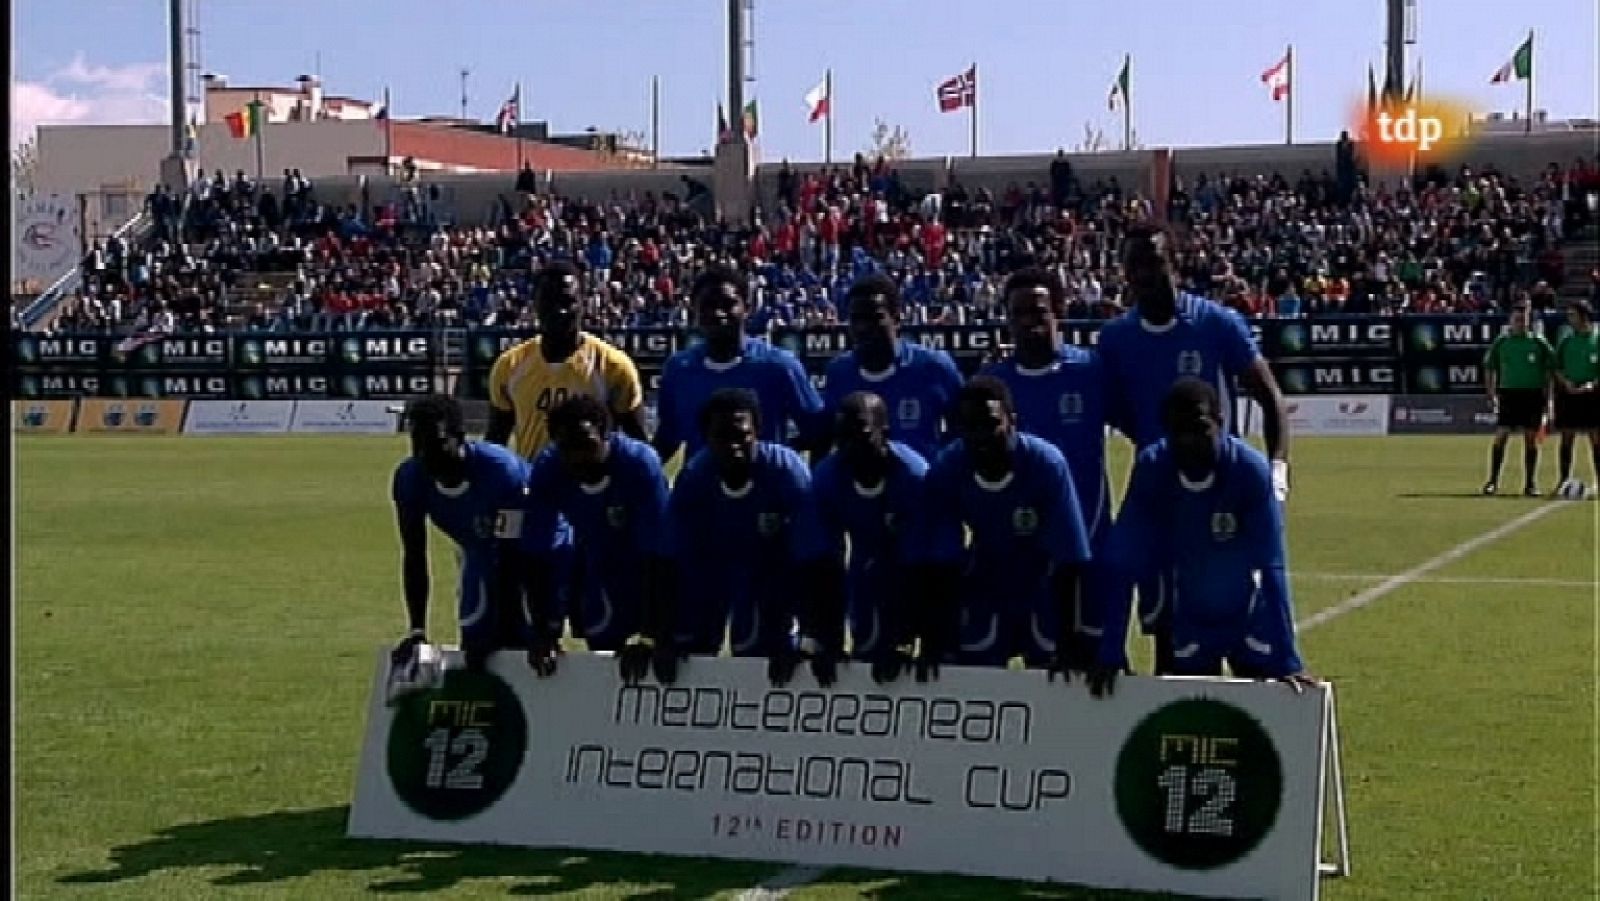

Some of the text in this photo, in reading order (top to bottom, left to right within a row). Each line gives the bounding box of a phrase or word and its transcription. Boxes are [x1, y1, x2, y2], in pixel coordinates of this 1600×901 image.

[806, 333, 847, 349] MI
[1311, 325, 1392, 342] MIC
[39, 339, 97, 355] MIC
[164, 339, 225, 356] MIC
[265, 339, 326, 356] MIC
[366, 338, 427, 355] MIC
[266, 376, 327, 392] MIC
[366, 375, 429, 392] MIC
[1315, 368, 1394, 383] MIC
[164, 377, 225, 392] MIC
[428, 701, 496, 727] MIC
[424, 727, 489, 789] 12
[1160, 734, 1239, 765] MIC
[966, 765, 1071, 811] CUP
[1157, 765, 1236, 837] 12
[776, 818, 902, 847] EDITION
